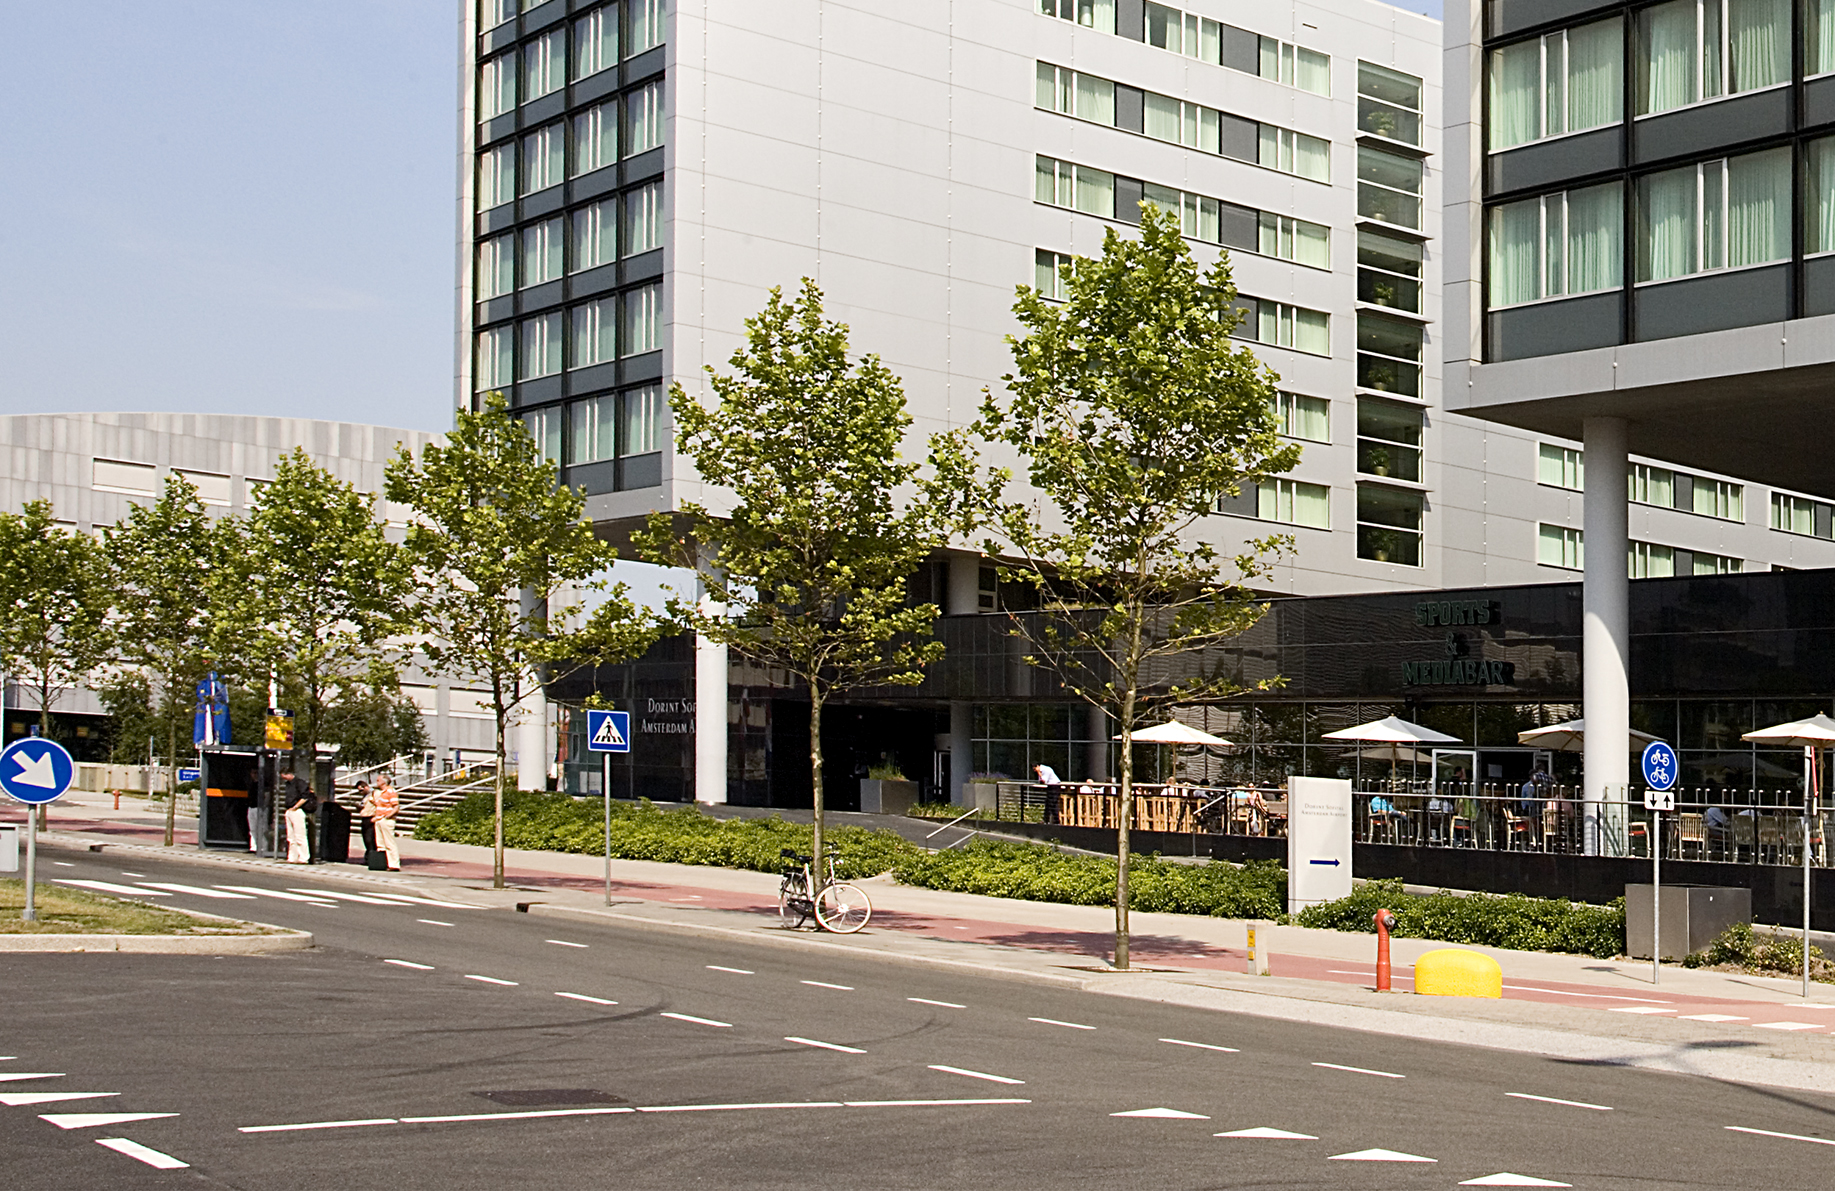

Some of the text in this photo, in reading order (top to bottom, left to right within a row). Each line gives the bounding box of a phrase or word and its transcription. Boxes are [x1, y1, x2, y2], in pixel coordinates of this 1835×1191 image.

[1415, 599, 1490, 626] SPORTS
[1445, 631, 1458, 656] &
[1401, 660, 1504, 685] MEDIABAR
[648, 698, 679, 713] DORINT
[641, 718, 688, 733] AMSTERDAM
